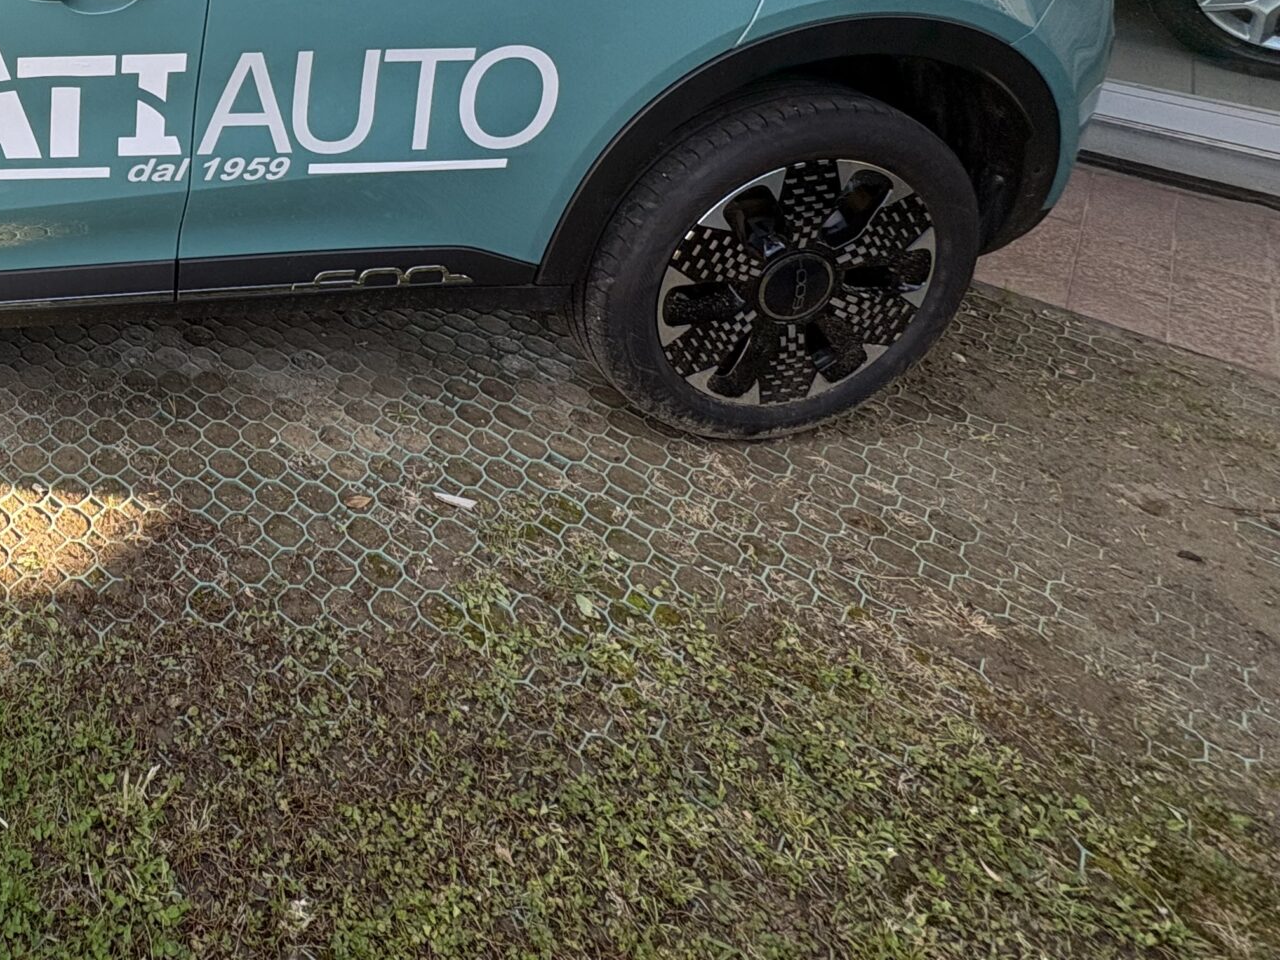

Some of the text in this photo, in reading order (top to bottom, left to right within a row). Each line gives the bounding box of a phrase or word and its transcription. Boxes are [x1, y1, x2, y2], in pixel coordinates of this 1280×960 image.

[196, 44, 559, 155] AUTO
[126, 155, 292, 184] dal 1959
